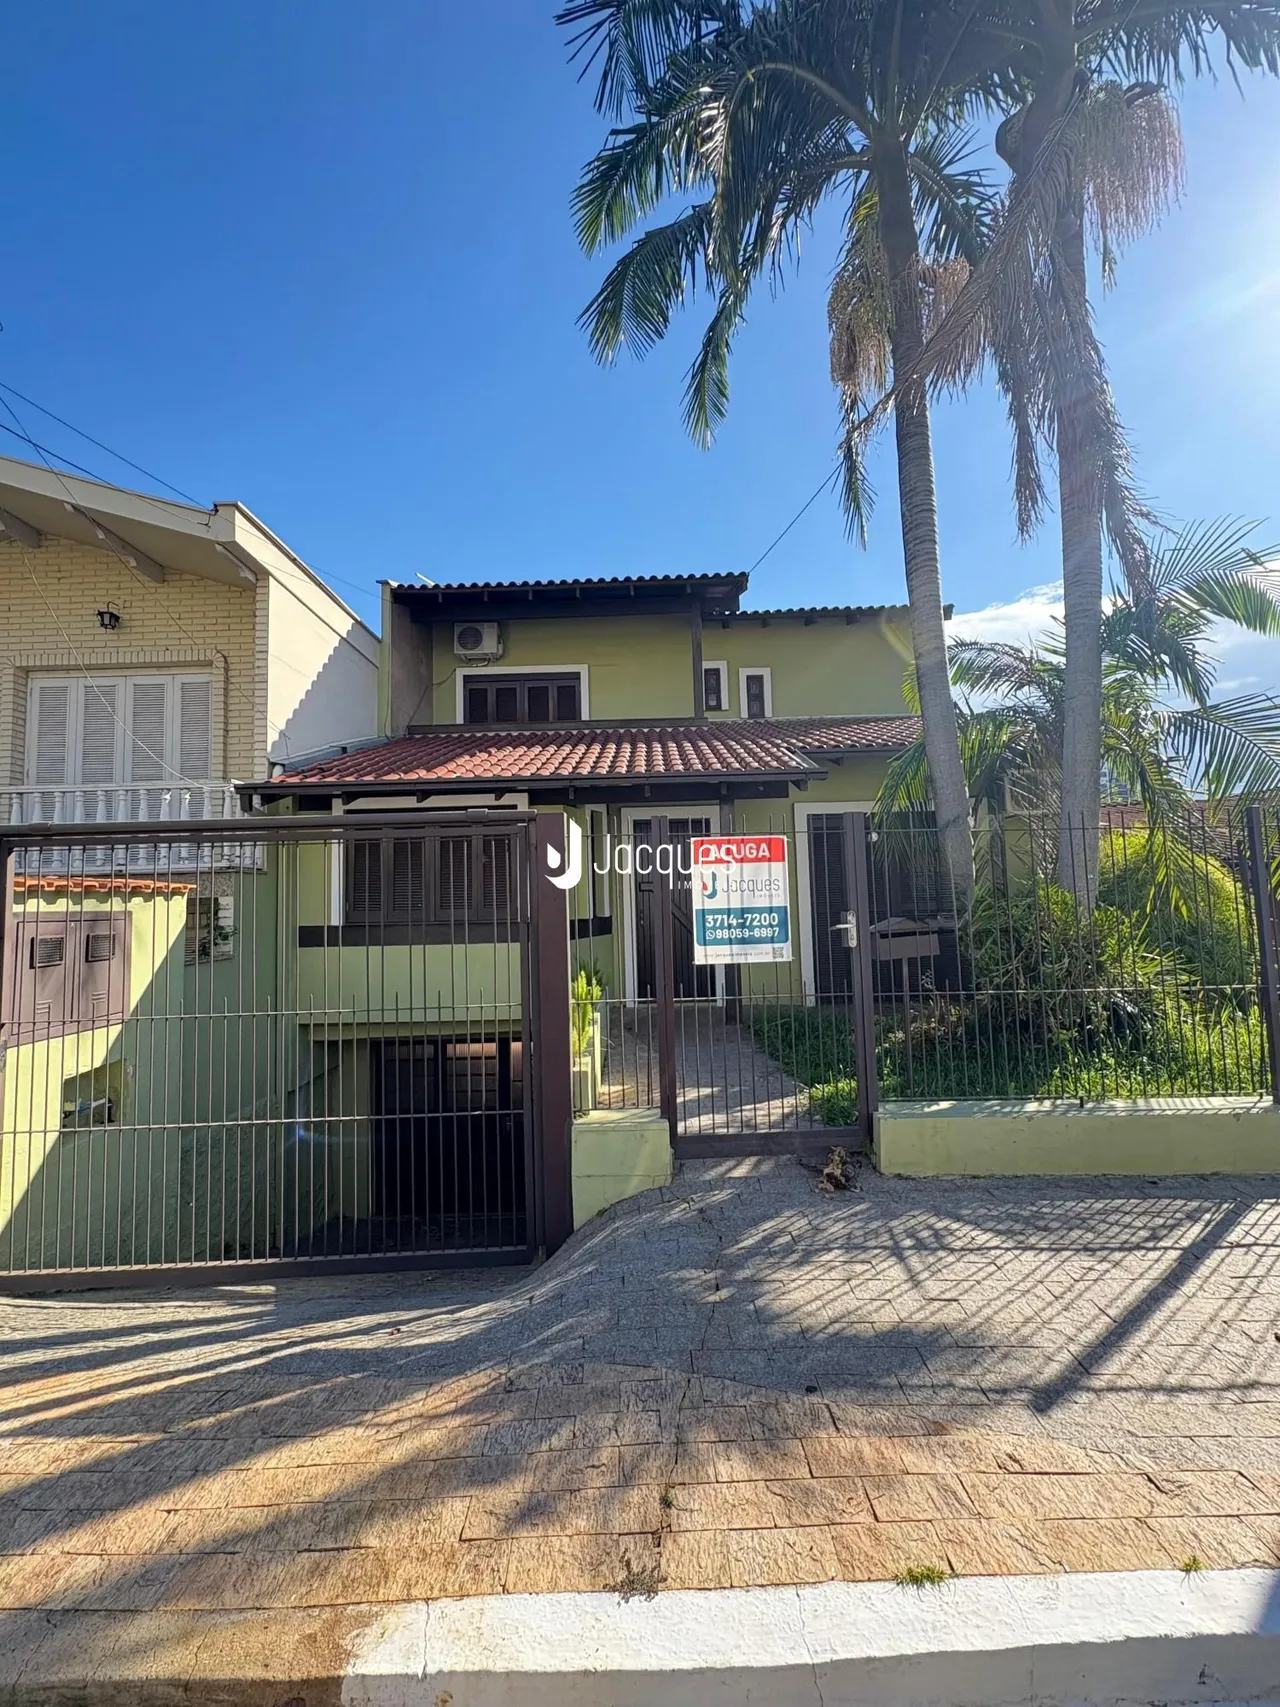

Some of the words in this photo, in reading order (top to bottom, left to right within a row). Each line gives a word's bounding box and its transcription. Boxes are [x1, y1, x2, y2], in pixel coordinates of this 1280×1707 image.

[708, 843, 771, 859] AUGA
[722, 875, 781, 899] Jacques
[705, 912, 779, 927] 3714-7200
[715, 927, 780, 939] 98059-6997
